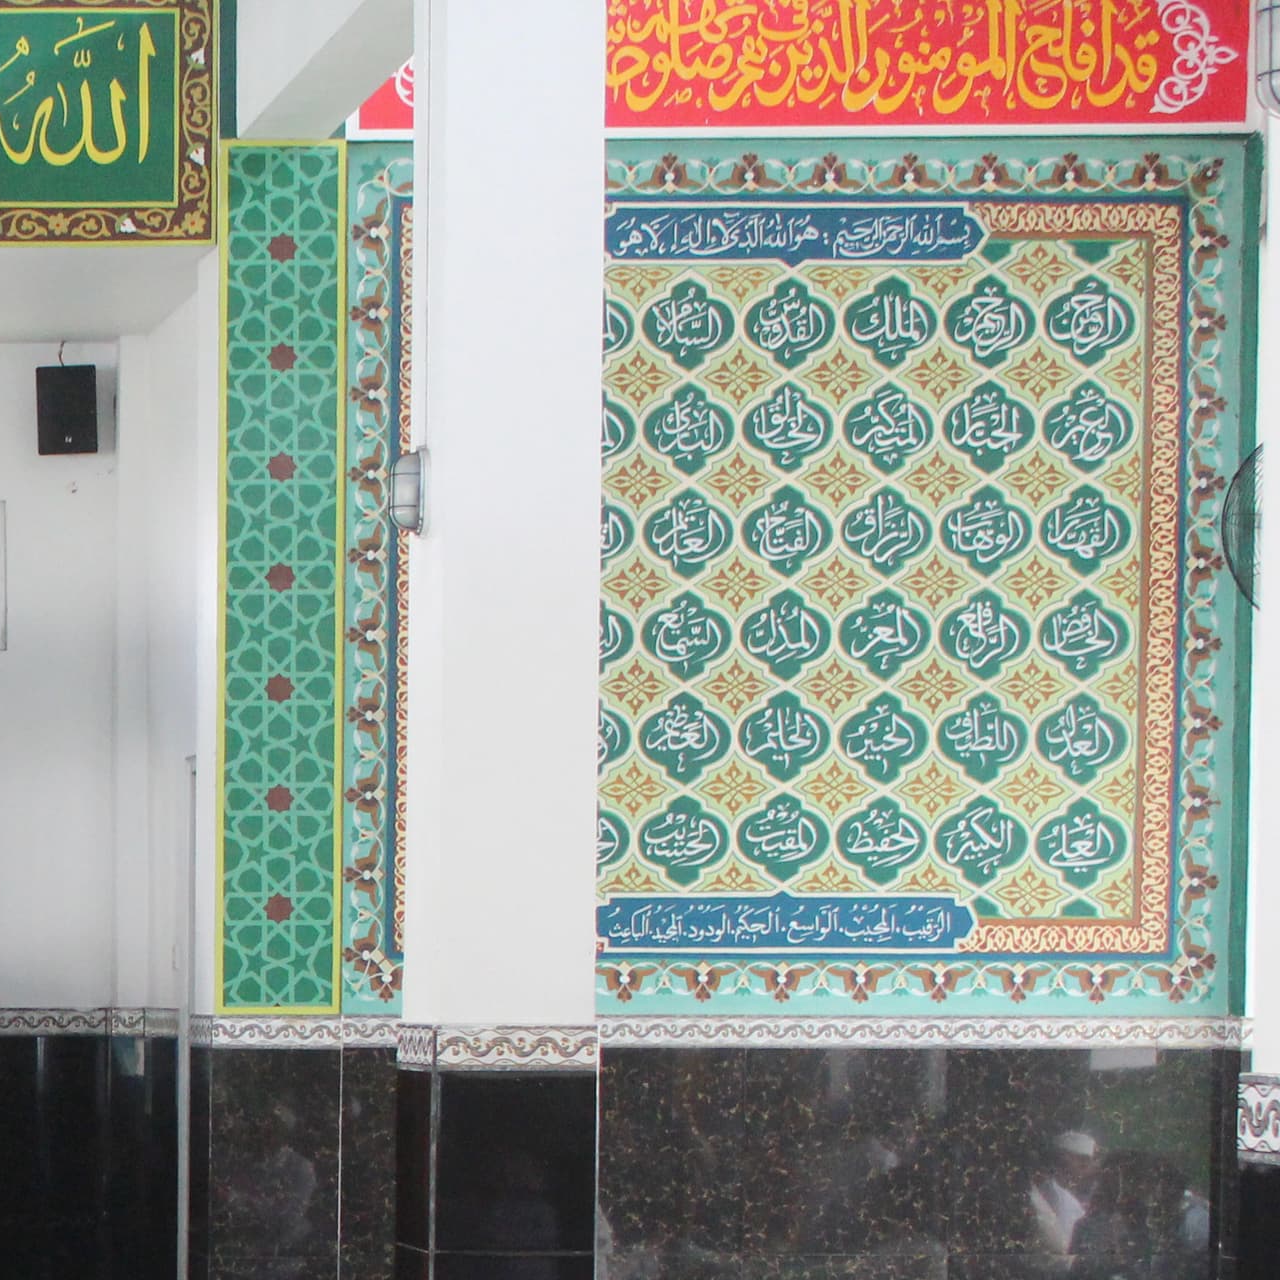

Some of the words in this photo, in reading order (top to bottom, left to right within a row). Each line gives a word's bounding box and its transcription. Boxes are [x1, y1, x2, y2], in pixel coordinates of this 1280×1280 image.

[851, 293, 929, 360] الملك
[954, 286, 1027, 358] الرحيم
[1049, 281, 1128, 356] الرحمن
